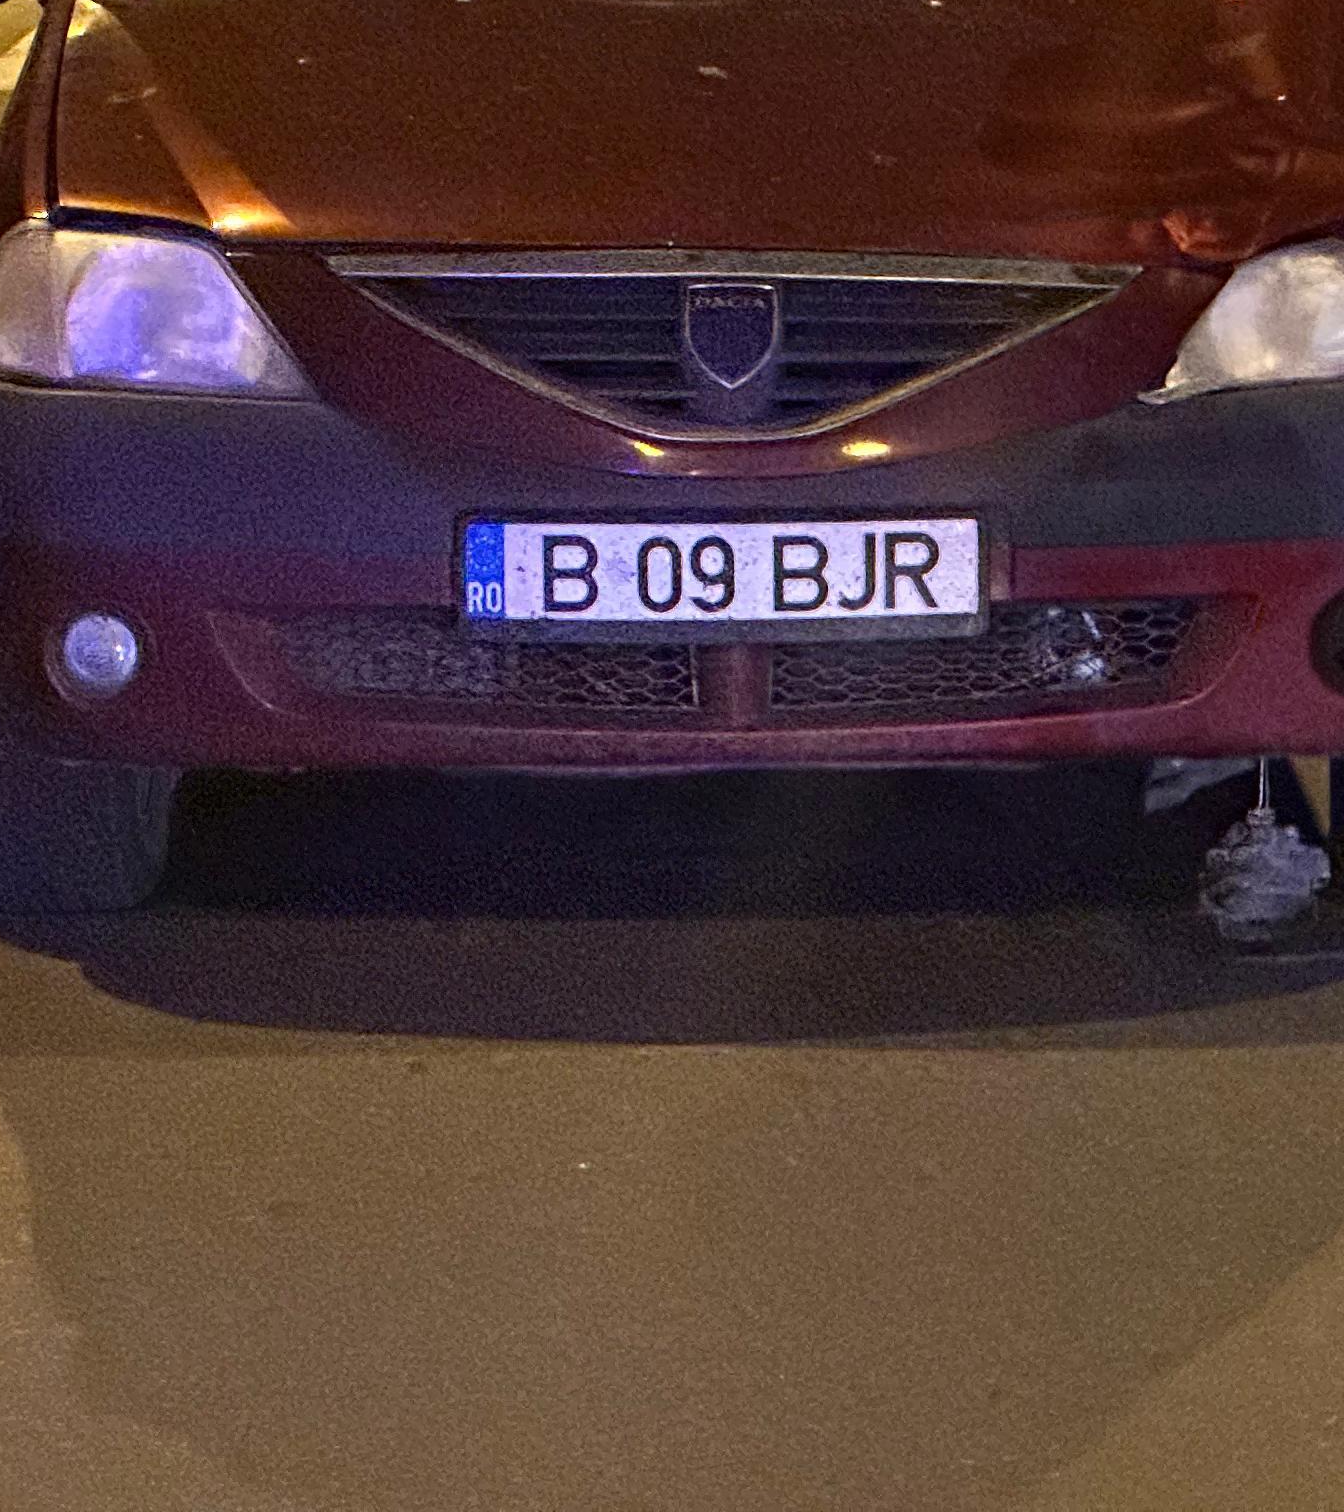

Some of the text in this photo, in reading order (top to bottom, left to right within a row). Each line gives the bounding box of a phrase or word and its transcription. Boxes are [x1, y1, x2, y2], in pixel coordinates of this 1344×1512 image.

[468, 581, 502, 613] RO
[542, 532, 940, 613] B 09 BJR
